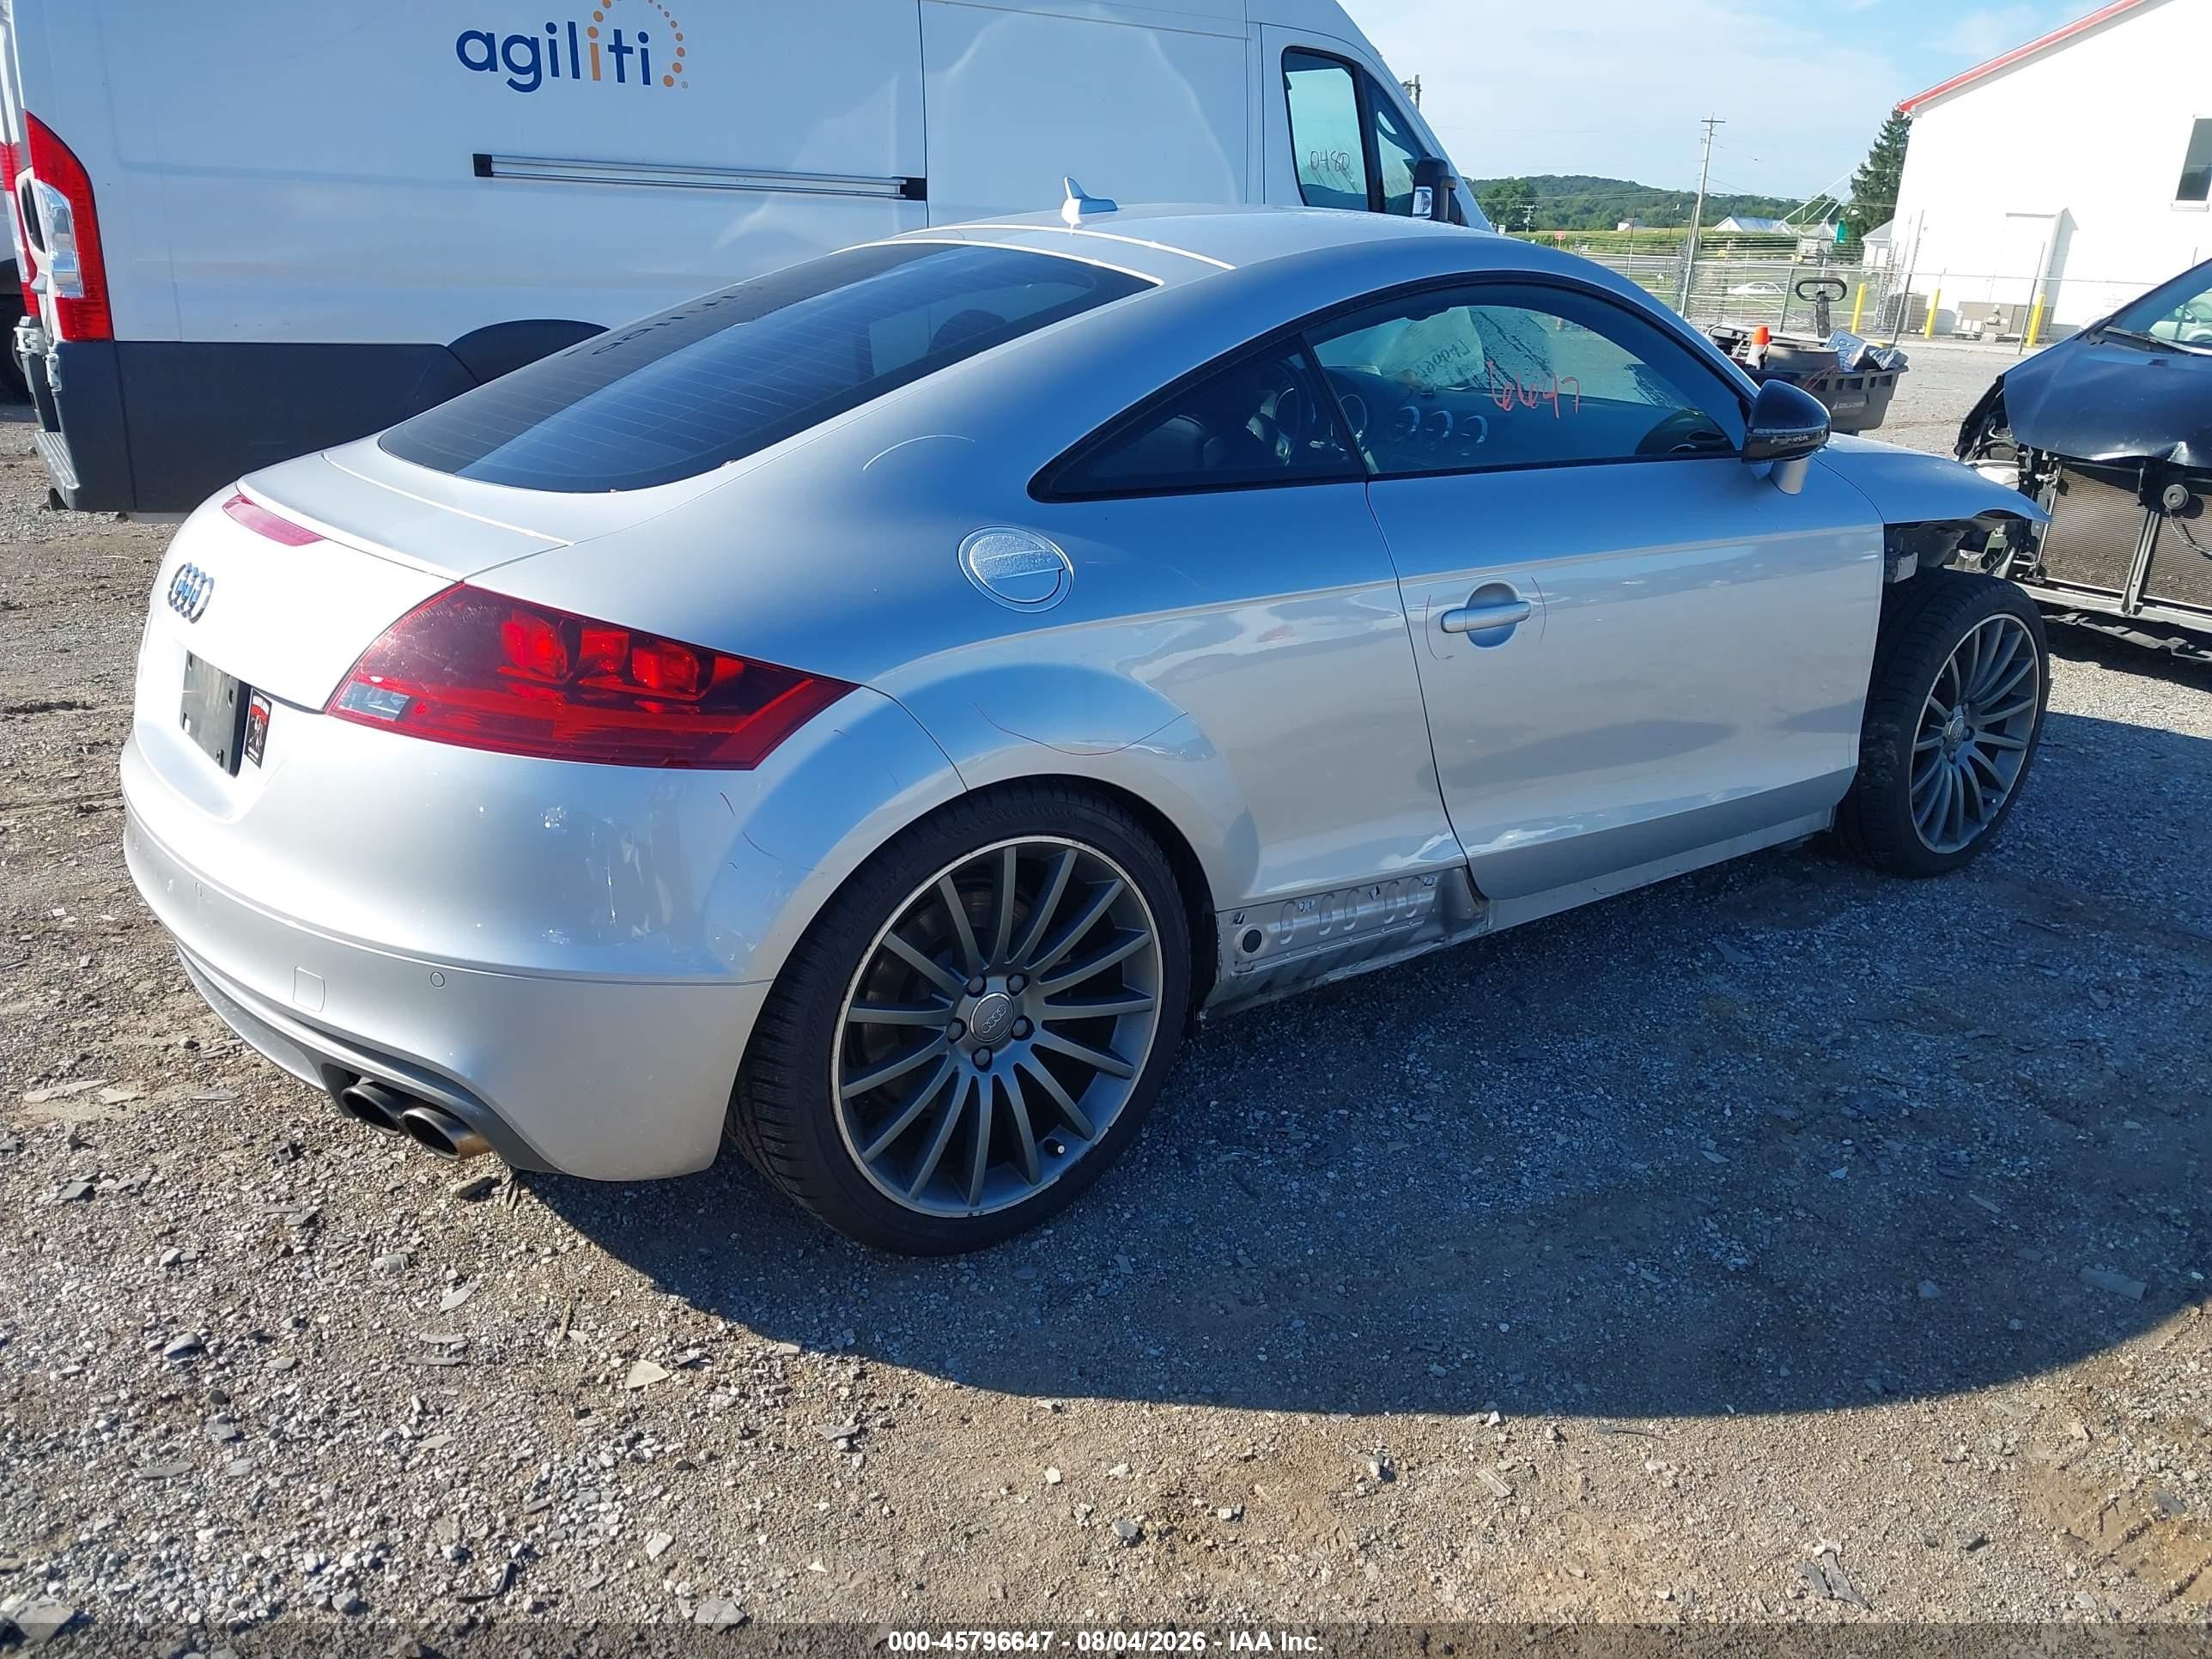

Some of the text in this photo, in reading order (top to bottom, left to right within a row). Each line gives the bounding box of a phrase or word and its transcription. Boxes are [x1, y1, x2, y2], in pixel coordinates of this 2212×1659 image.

[456, 21, 651, 93] agiliti
[1310, 149, 1351, 172] 0480
[1487, 360, 1580, 419] 6647
